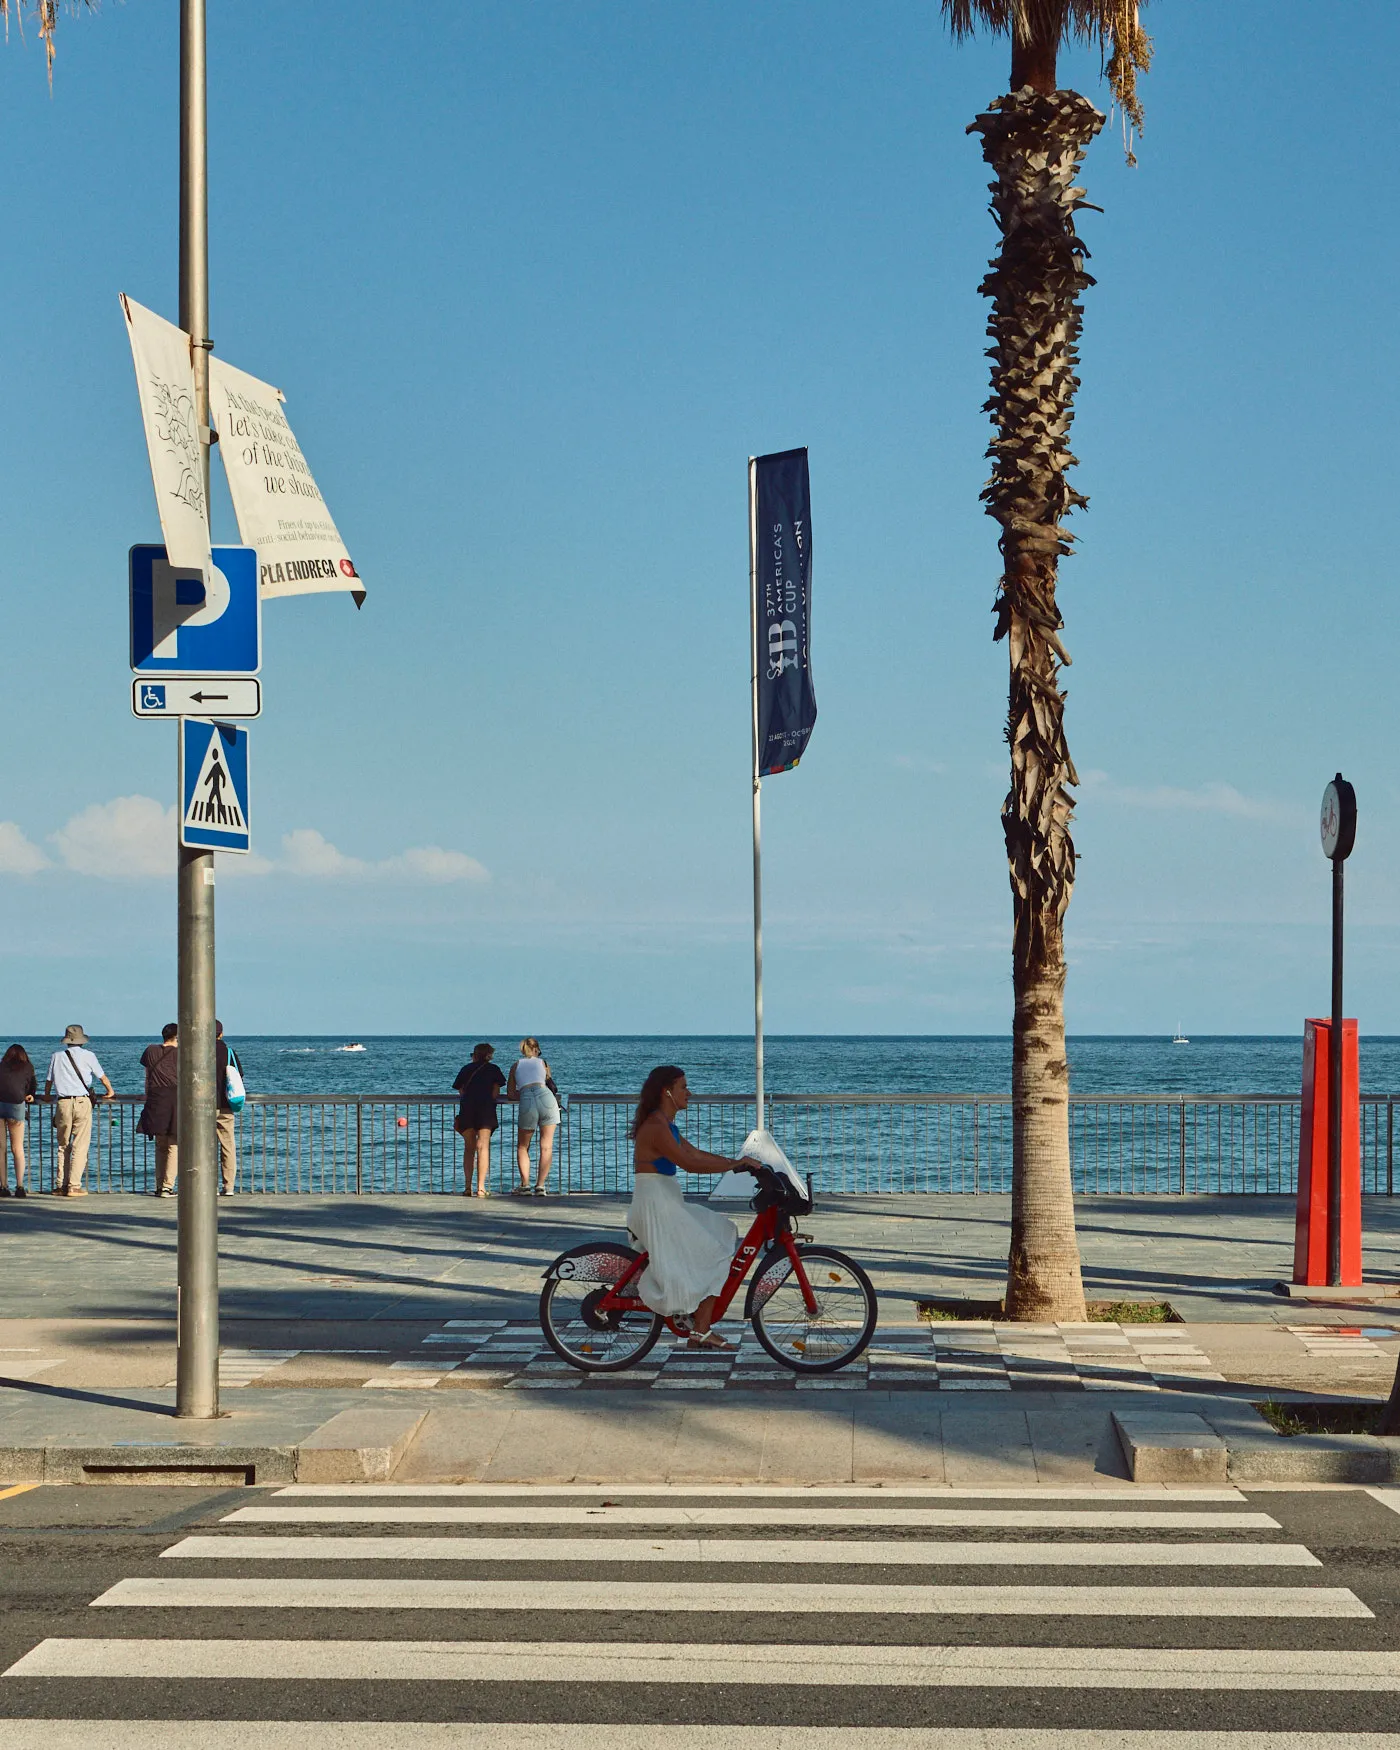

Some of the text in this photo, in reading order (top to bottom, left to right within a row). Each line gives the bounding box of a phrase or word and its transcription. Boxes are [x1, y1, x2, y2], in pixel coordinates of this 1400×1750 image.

[224, 386, 241, 410] At
[238, 393, 261, 416] the
[229, 412, 260, 438] let's
[259, 422, 286, 447] take
[242, 441, 311, 477] of the thin
[264, 476, 286, 493] we
[277, 519, 295, 530] Fines
[295, 519, 303, 529] of
[261, 562, 286, 586] PLA
[774, 523, 783, 614] AMERICA'S
[152, 559, 231, 658] P
[766, 583, 776, 617] 37TH
[785, 580, 796, 613] CUP
